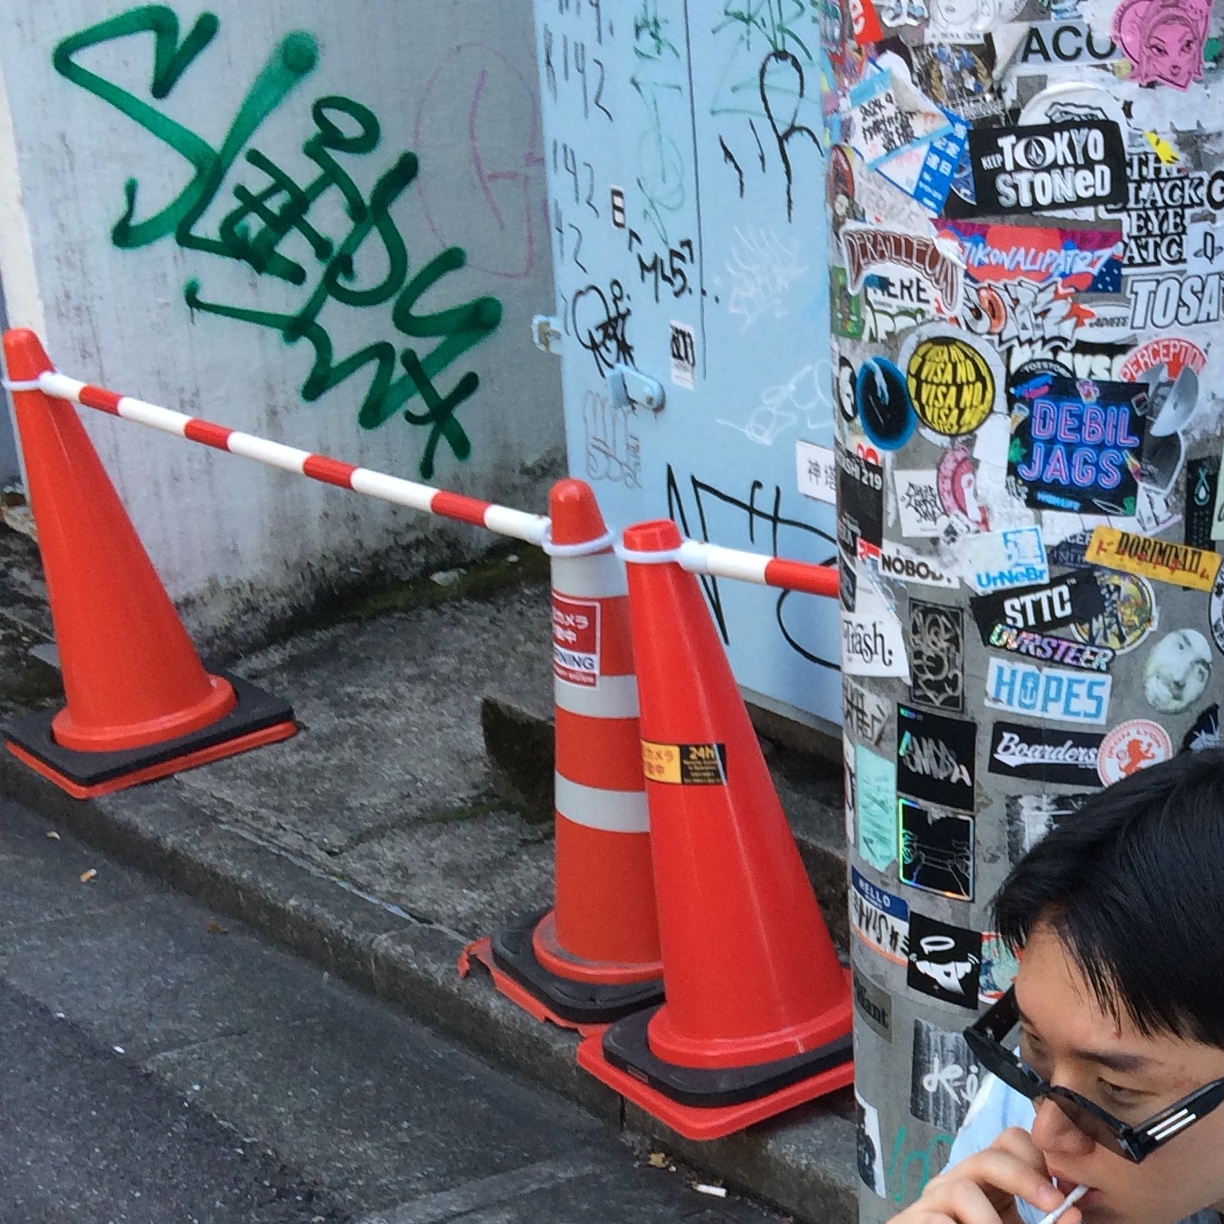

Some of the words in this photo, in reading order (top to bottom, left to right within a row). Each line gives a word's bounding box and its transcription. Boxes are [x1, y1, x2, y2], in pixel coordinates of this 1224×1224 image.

[980, 153, 1003, 171] KEEP
[997, 127, 1105, 172] TOKYO
[1110, 178, 1202, 209] LACK
[1130, 210, 1183, 237] EYE
[920, 361, 953, 384] VISA
[956, 358, 977, 384] NO
[921, 383, 957, 409] VISA
[959, 380, 984, 409] NO
[1031, 398, 1141, 448] DEBIL
[861, 468, 882, 492] 219
[1017, 442, 1122, 490] JAGS
[1003, 584, 1073, 629] STTC
[993, 665, 1106, 719] HOPES
[994, 731, 1098, 766] Boarders
[858, 878, 892, 909] HELLO
